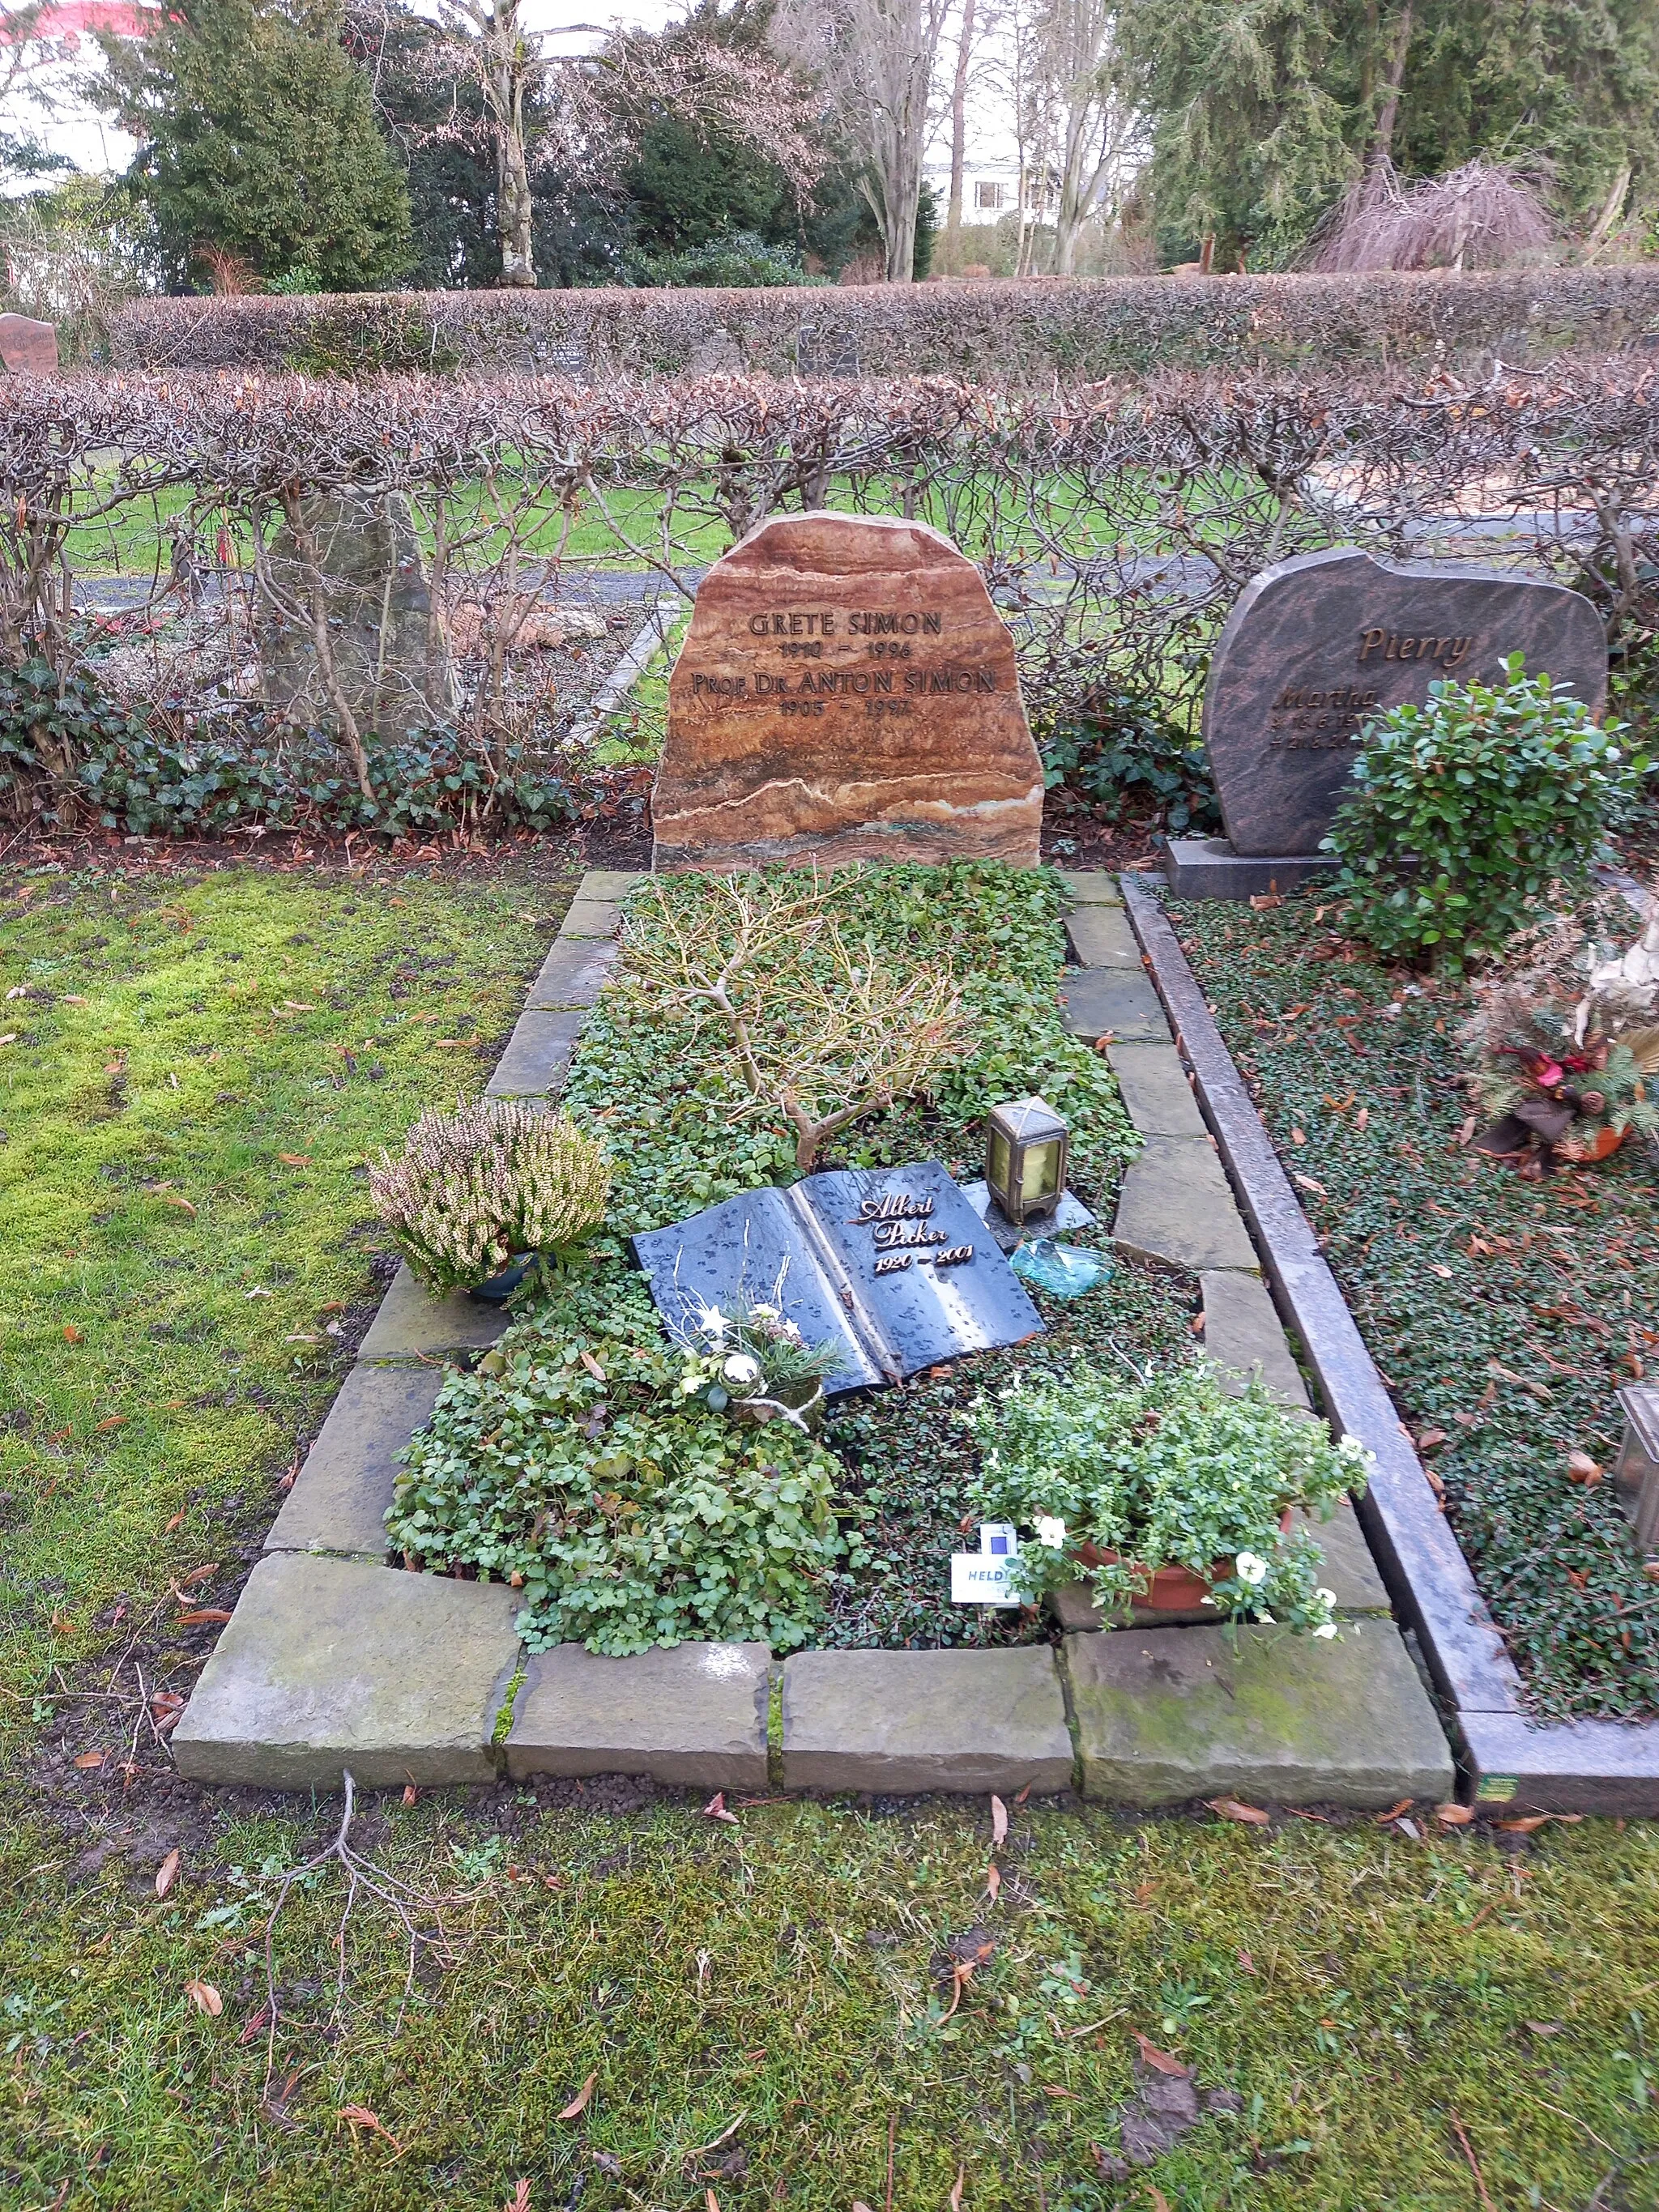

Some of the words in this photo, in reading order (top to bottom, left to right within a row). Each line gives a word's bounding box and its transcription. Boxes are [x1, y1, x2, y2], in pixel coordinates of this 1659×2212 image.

[749, 612, 835, 636] GRETE
[848, 612, 942, 635] SIMON
[779, 639, 825, 659] 1910
[867, 640, 912, 658] 1996
[1358, 627, 1473, 669] Pierry
[797, 671, 893, 694] ANTON
[904, 670, 997, 693] SIMON
[778, 699, 827, 718] 1905
[864, 698, 913, 717] 1997
[859, 1193, 936, 1221] Albert
[873, 1221, 949, 1251] Picker
[875, 1253, 913, 1276] 1920
[935, 1244, 974, 1266] 2001
